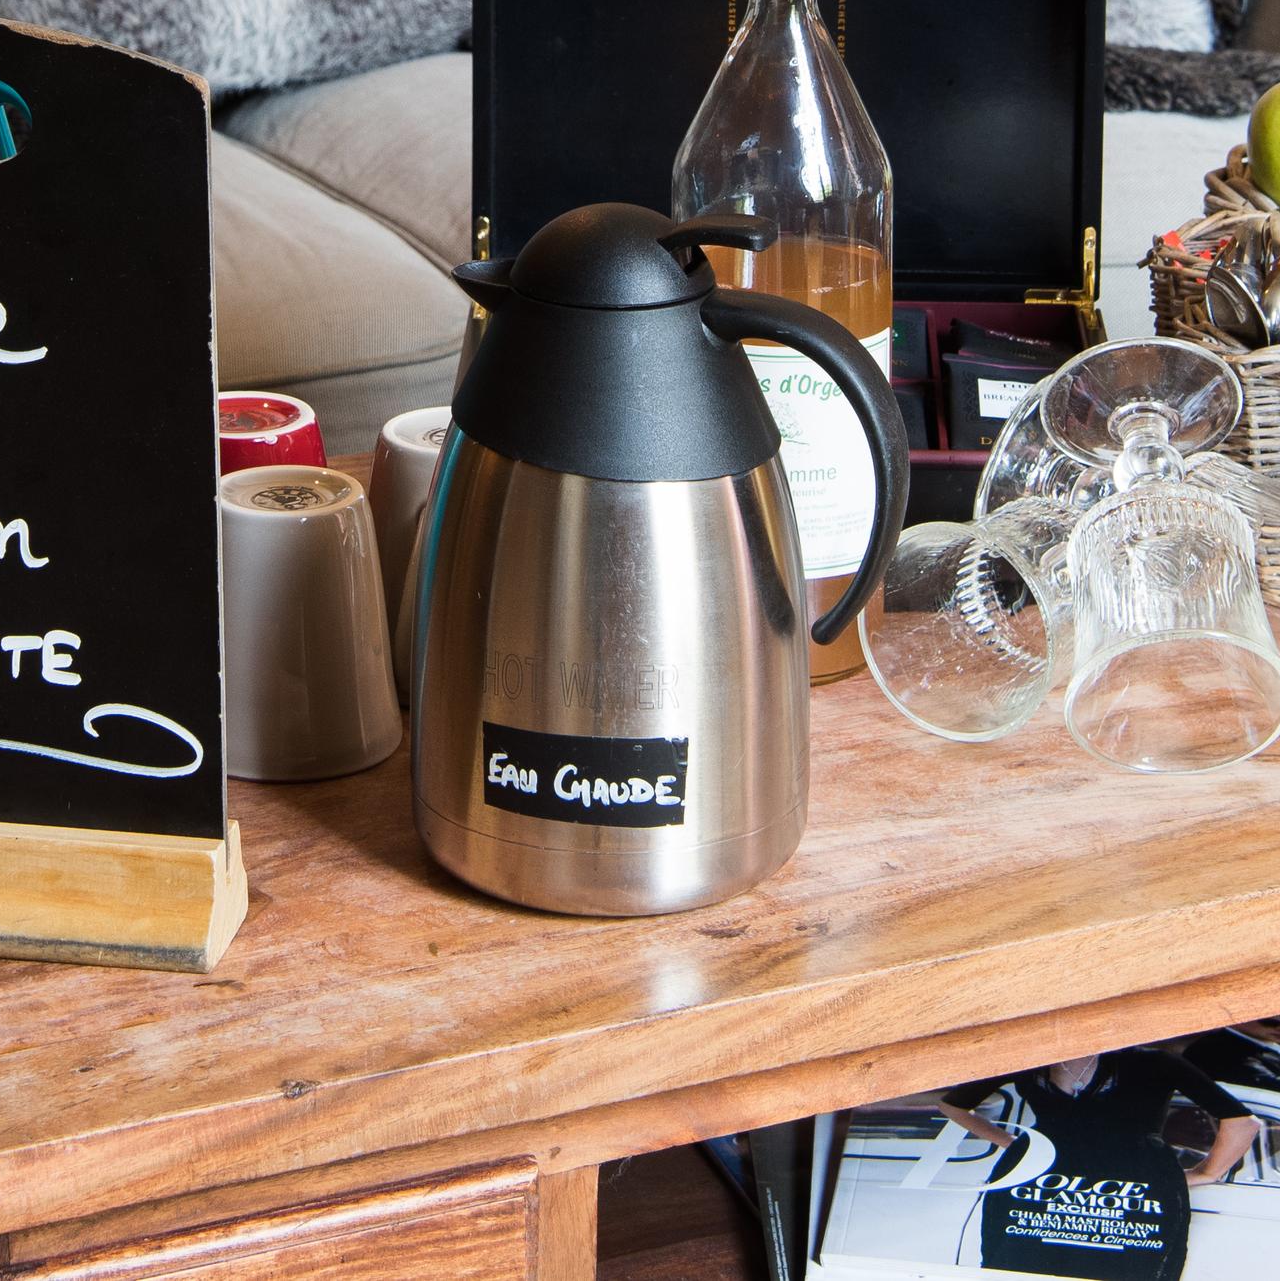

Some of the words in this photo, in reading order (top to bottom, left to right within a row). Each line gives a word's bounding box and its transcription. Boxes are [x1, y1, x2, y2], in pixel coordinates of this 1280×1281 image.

[779, 373, 842, 401] d'Orge
[983, 393, 1022, 402] BREAK
[788, 466, 838, 483] mme
[483, 651, 548, 704] HOT
[560, 660, 680, 711] WATER
[487, 752, 539, 795] EAU
[1010, 1186, 1163, 1214] GLAMOUR
[1046, 1202, 1125, 1218] EXCLUSIF
[1009, 1209, 1061, 1222] CHIARA
[1065, 1216, 1160, 1233] MASTROIANNI
[1017, 1218, 1028, 1226] &
[1030, 1219, 1098, 1233] BENJAMIN
[1101, 1226, 1150, 1239] BIOLAY
[1005, 1225, 1088, 1241] Confidences
[1091, 1233, 1101, 1243] à
[1103, 1235, 1164, 1249] Cinecittà
